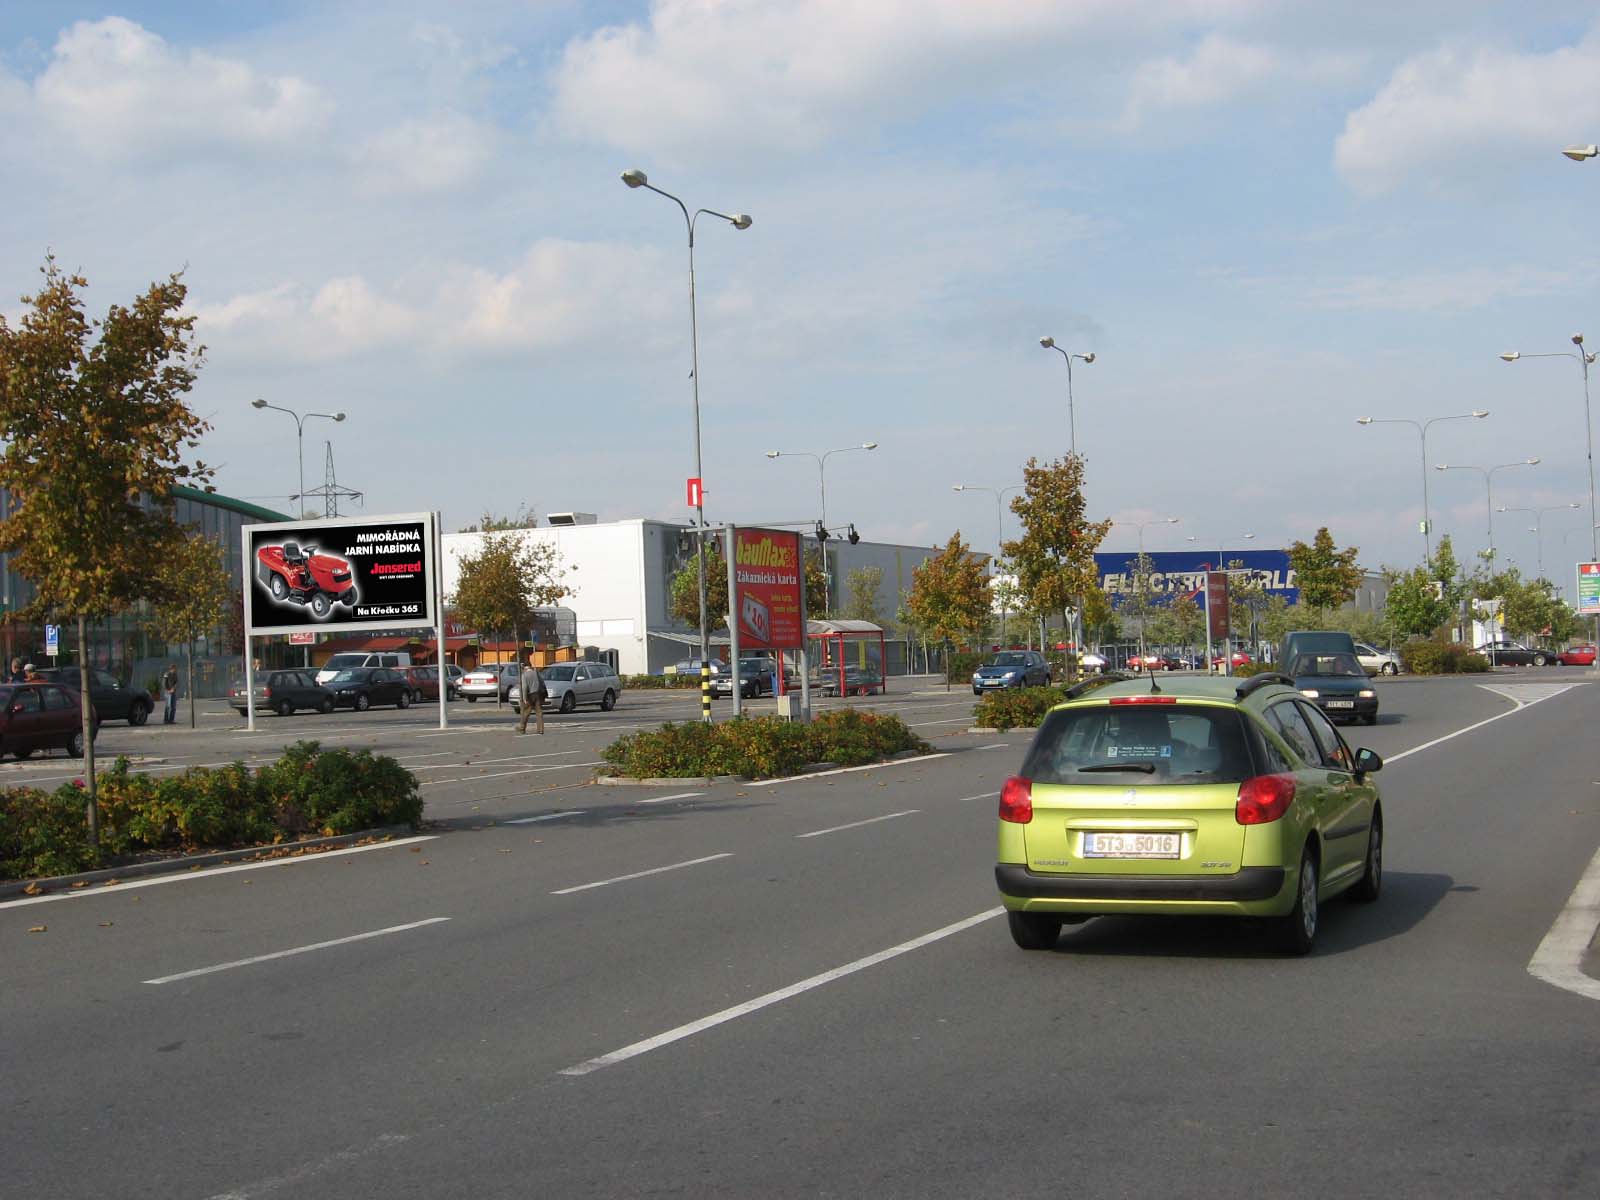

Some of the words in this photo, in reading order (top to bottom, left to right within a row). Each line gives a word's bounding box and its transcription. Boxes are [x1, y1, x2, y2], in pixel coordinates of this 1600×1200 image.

[357, 529, 420, 543] MIMOŘÁDNÁ
[345, 543, 373, 555] JARNÍ
[375, 542, 421, 554] NABÍDKA
[370, 560, 421, 574] Jonsered
[737, 571, 776, 584] Zákaznická
[777, 572, 797, 584] karta
[357, 607, 369, 616] Na
[401, 604, 418, 614] 365
[1096, 835, 1124, 851] 5T3
[1135, 835, 1173, 851] 5016
